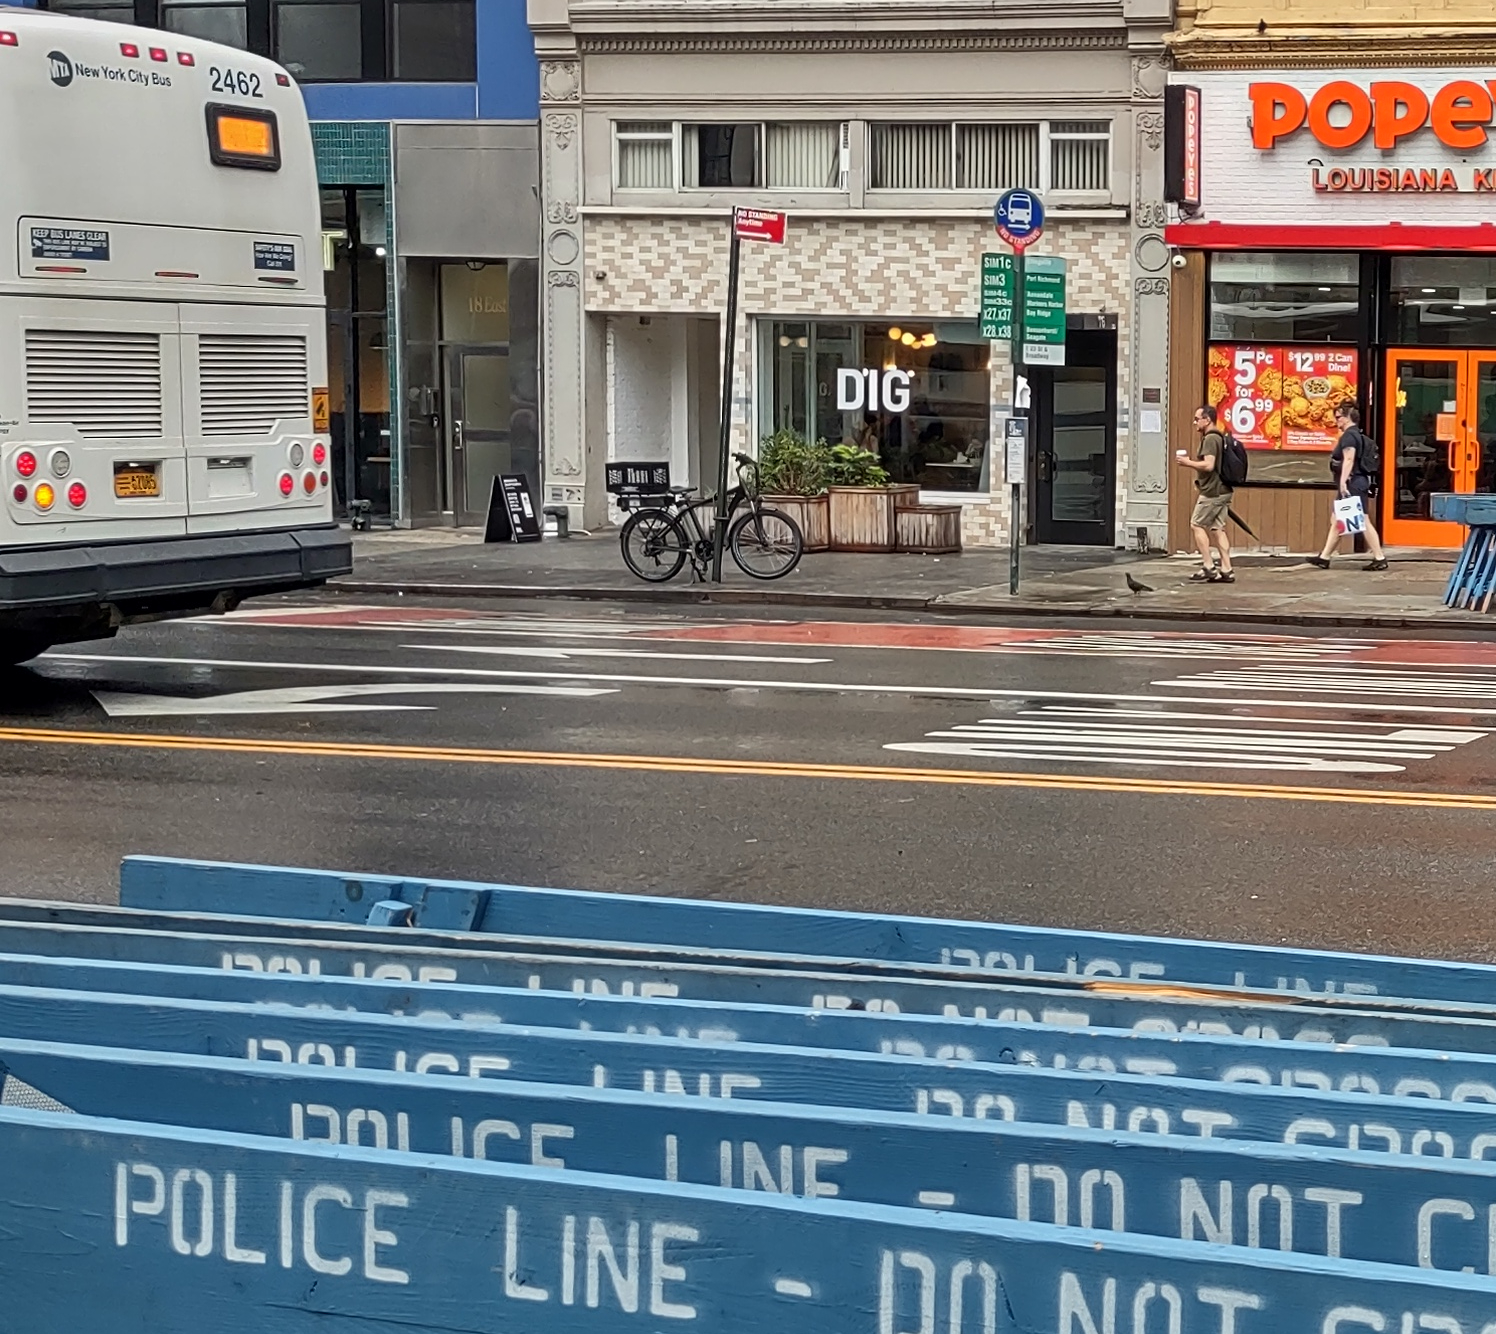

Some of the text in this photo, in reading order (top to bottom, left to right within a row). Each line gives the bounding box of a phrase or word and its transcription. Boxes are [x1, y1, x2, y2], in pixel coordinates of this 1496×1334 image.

[75, 63, 100, 79] New
[100, 66, 126, 82] York
[128, 69, 149, 87] City
[152, 73, 172, 87] Bus
[209, 67, 263, 98] 2462
[1312, 168, 1457, 191] LOUISIANA
[738, 210, 778, 221] NO STANDING
[999, 228, 1041, 245] NO STANDING
[984, 256, 1011, 269] SIM1c
[984, 274, 1006, 286] SIM3
[468, 296, 507, 313] 18 East
[1328, 353, 1353, 362] 2 Can
[1328, 363, 1351, 372] Dine!
[837, 368, 910, 412] DIG
[1234, 386, 1255, 397] for
[1180, 1177, 1363, 1258] NOT
[114, 1161, 410, 1284] POLICE
[503, 1205, 699, 1319] LINE
